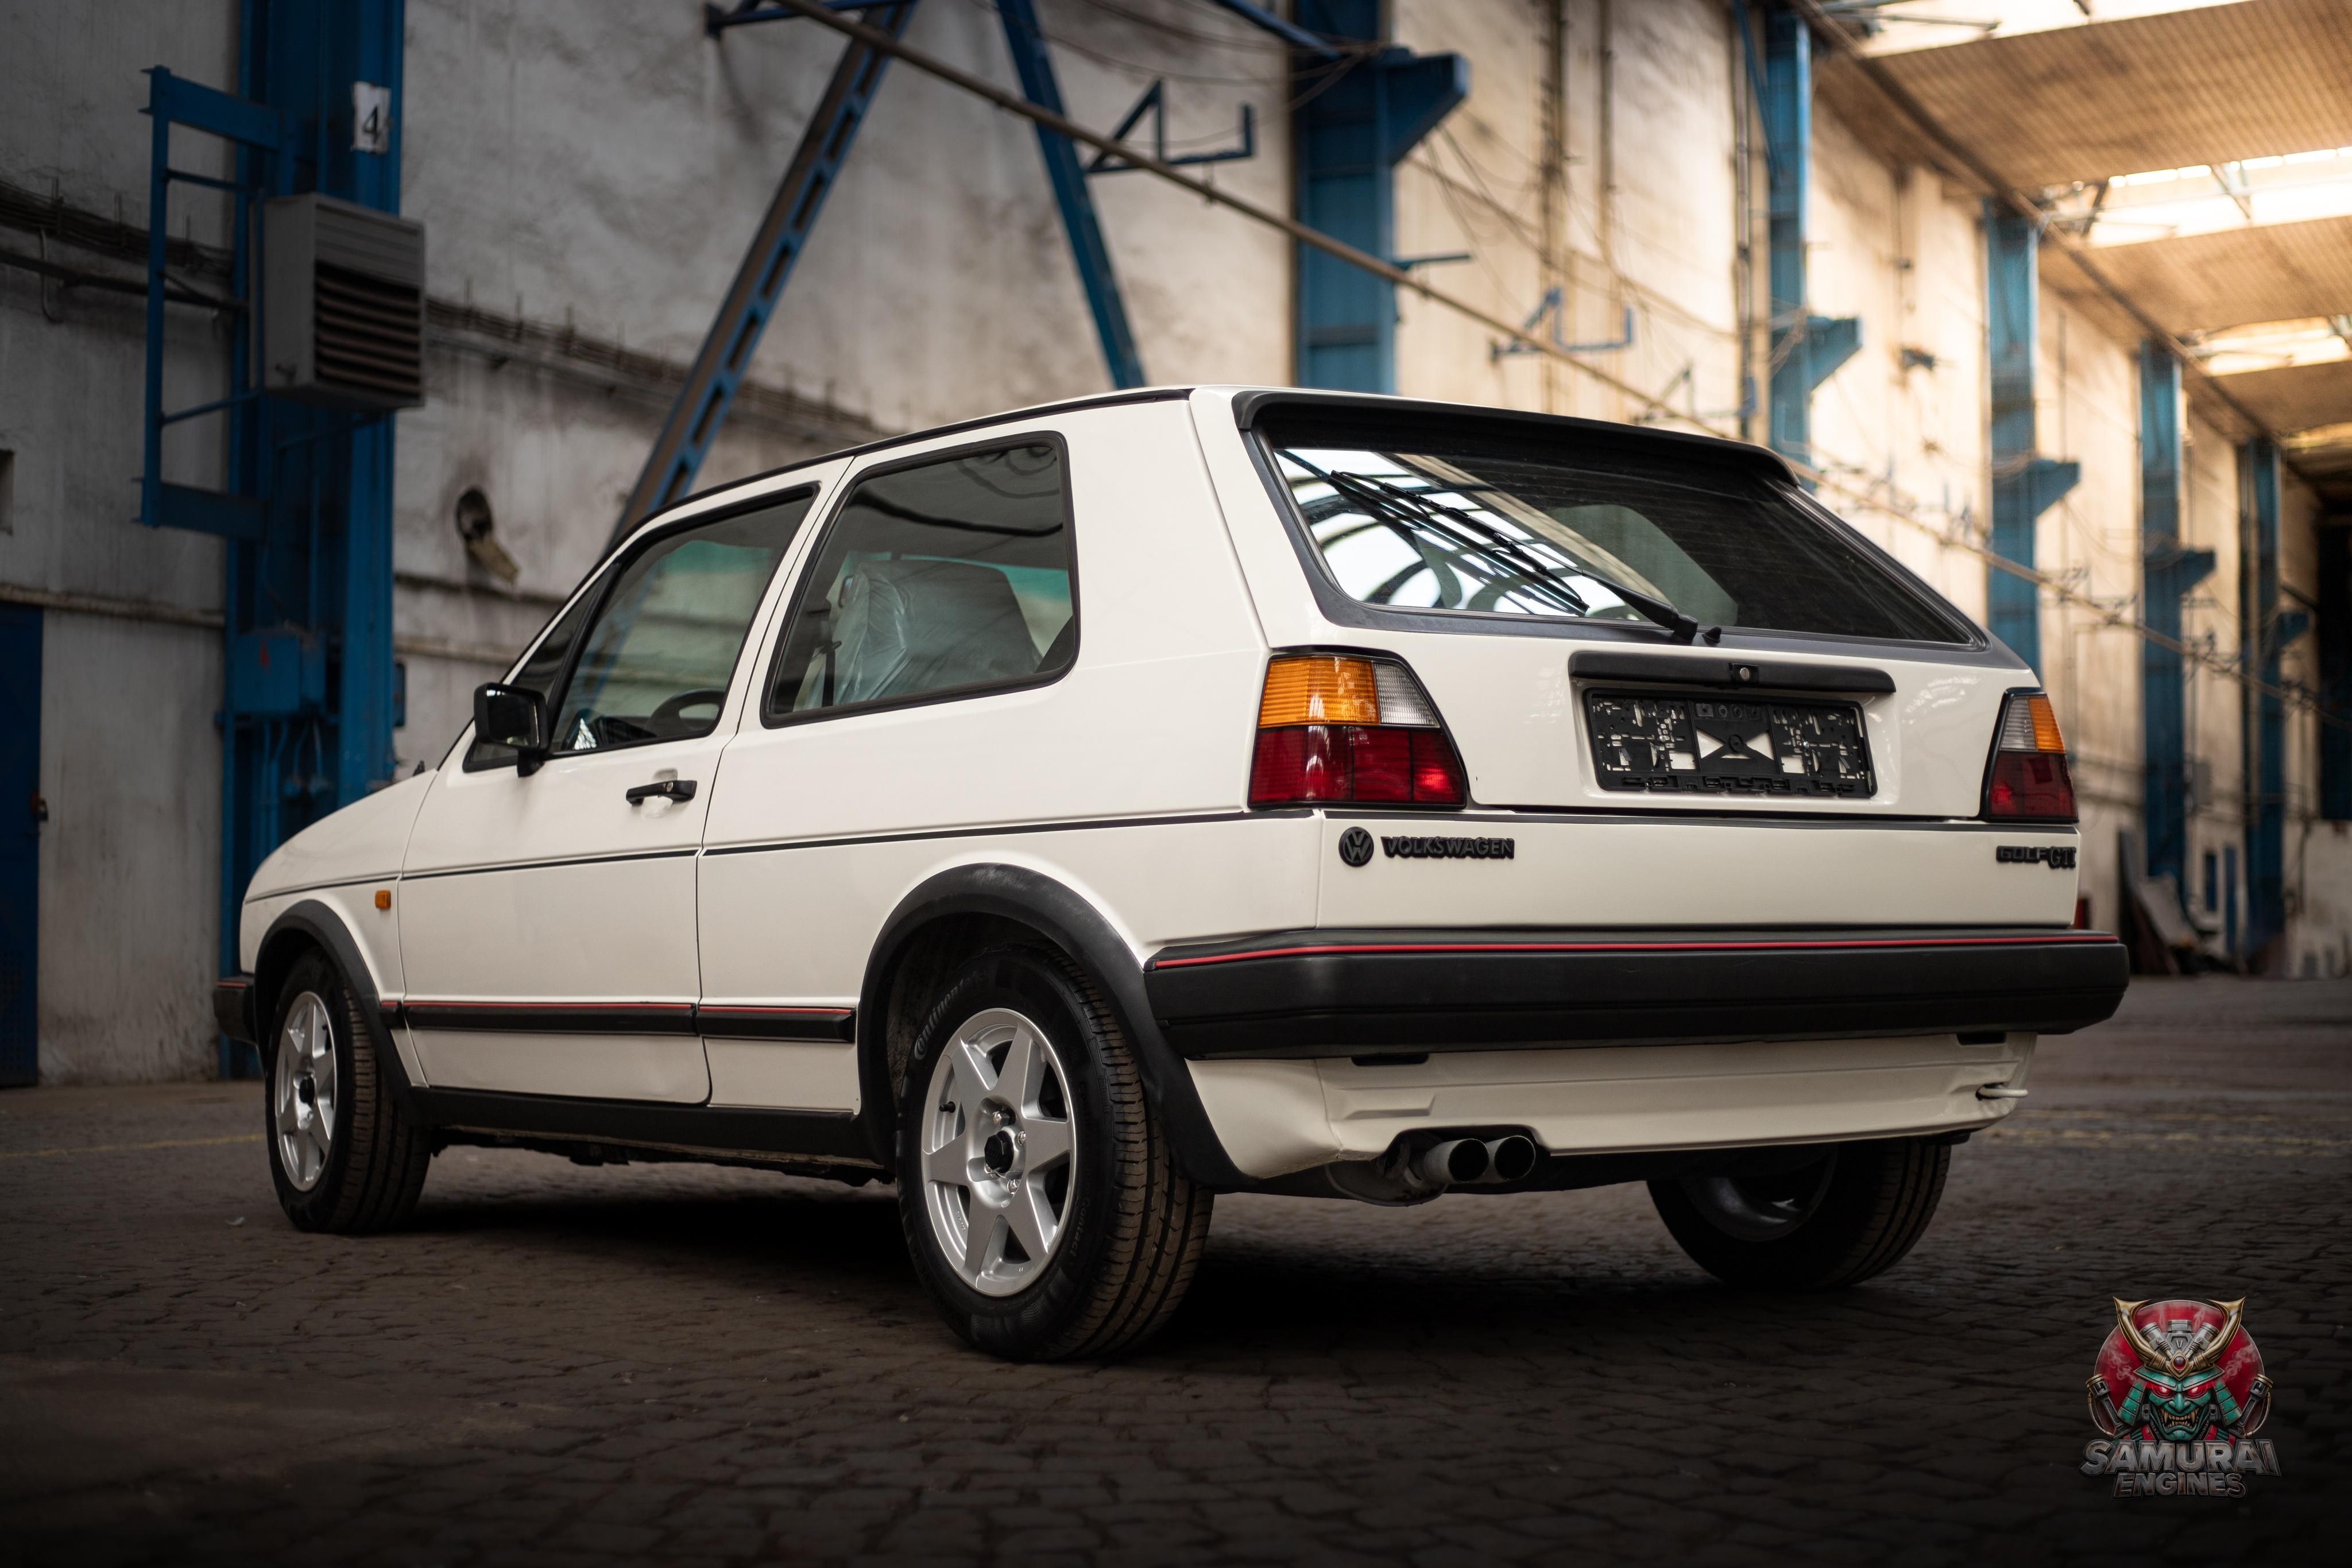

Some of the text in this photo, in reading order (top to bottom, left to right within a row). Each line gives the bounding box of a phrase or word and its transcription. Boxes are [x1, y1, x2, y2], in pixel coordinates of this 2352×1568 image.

[362, 104, 382, 144] 4
[1380, 836, 1515, 859] VOLKSWAGEN
[1996, 846, 2077, 869] GOLF GTI
